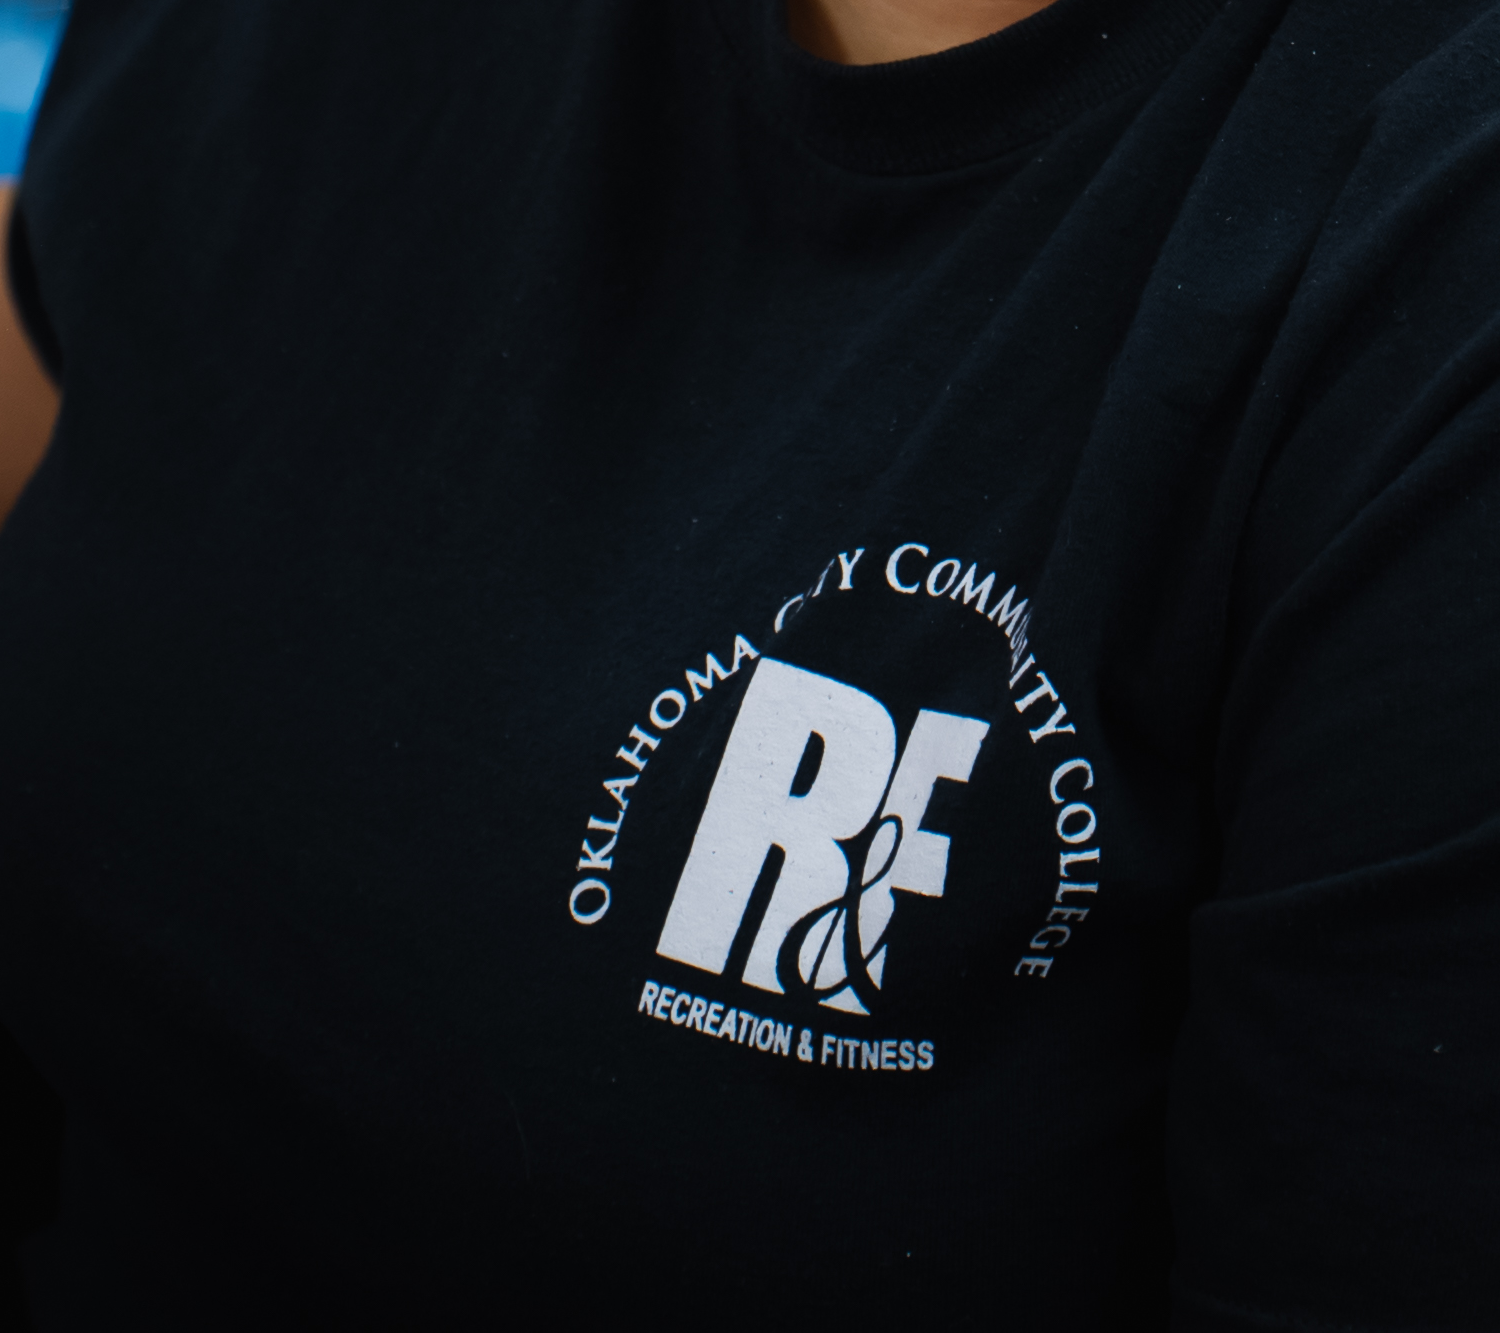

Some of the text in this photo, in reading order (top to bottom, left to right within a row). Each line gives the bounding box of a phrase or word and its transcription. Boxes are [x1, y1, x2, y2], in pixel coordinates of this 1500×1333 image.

[568, 634, 761, 925] OKLAHOMA
[773, 546, 866, 634] CY
[1013, 757, 1101, 979] COLLEGE
[637, 980, 935, 1071] RECREATION & FITNESS
